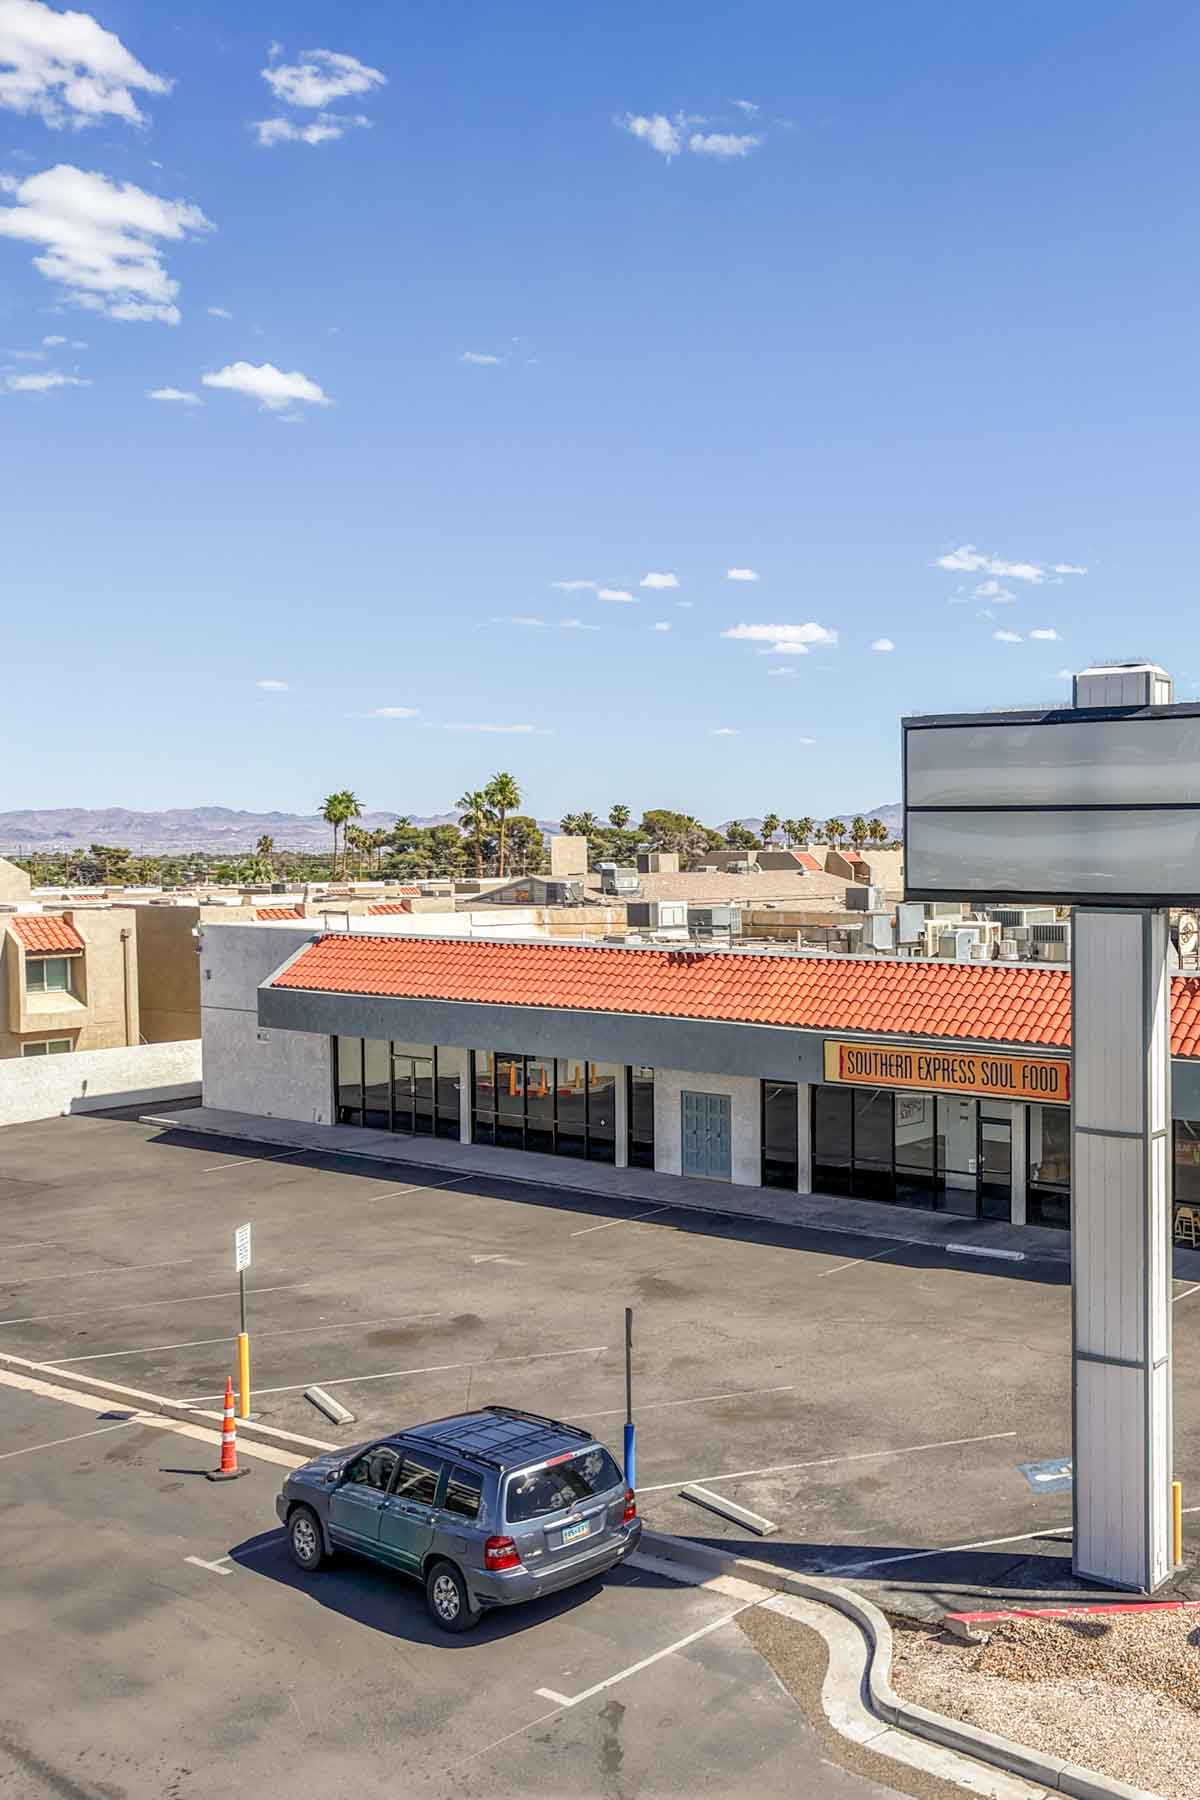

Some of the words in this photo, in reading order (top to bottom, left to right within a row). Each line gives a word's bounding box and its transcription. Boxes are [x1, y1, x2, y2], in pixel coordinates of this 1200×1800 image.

[847, 1050, 912, 1079] SOUTHERN
[918, 1056, 976, 1085] EXPRESS
[981, 1061, 1017, 1089] SOUL
[1022, 1065, 1058, 1093] FOOD
